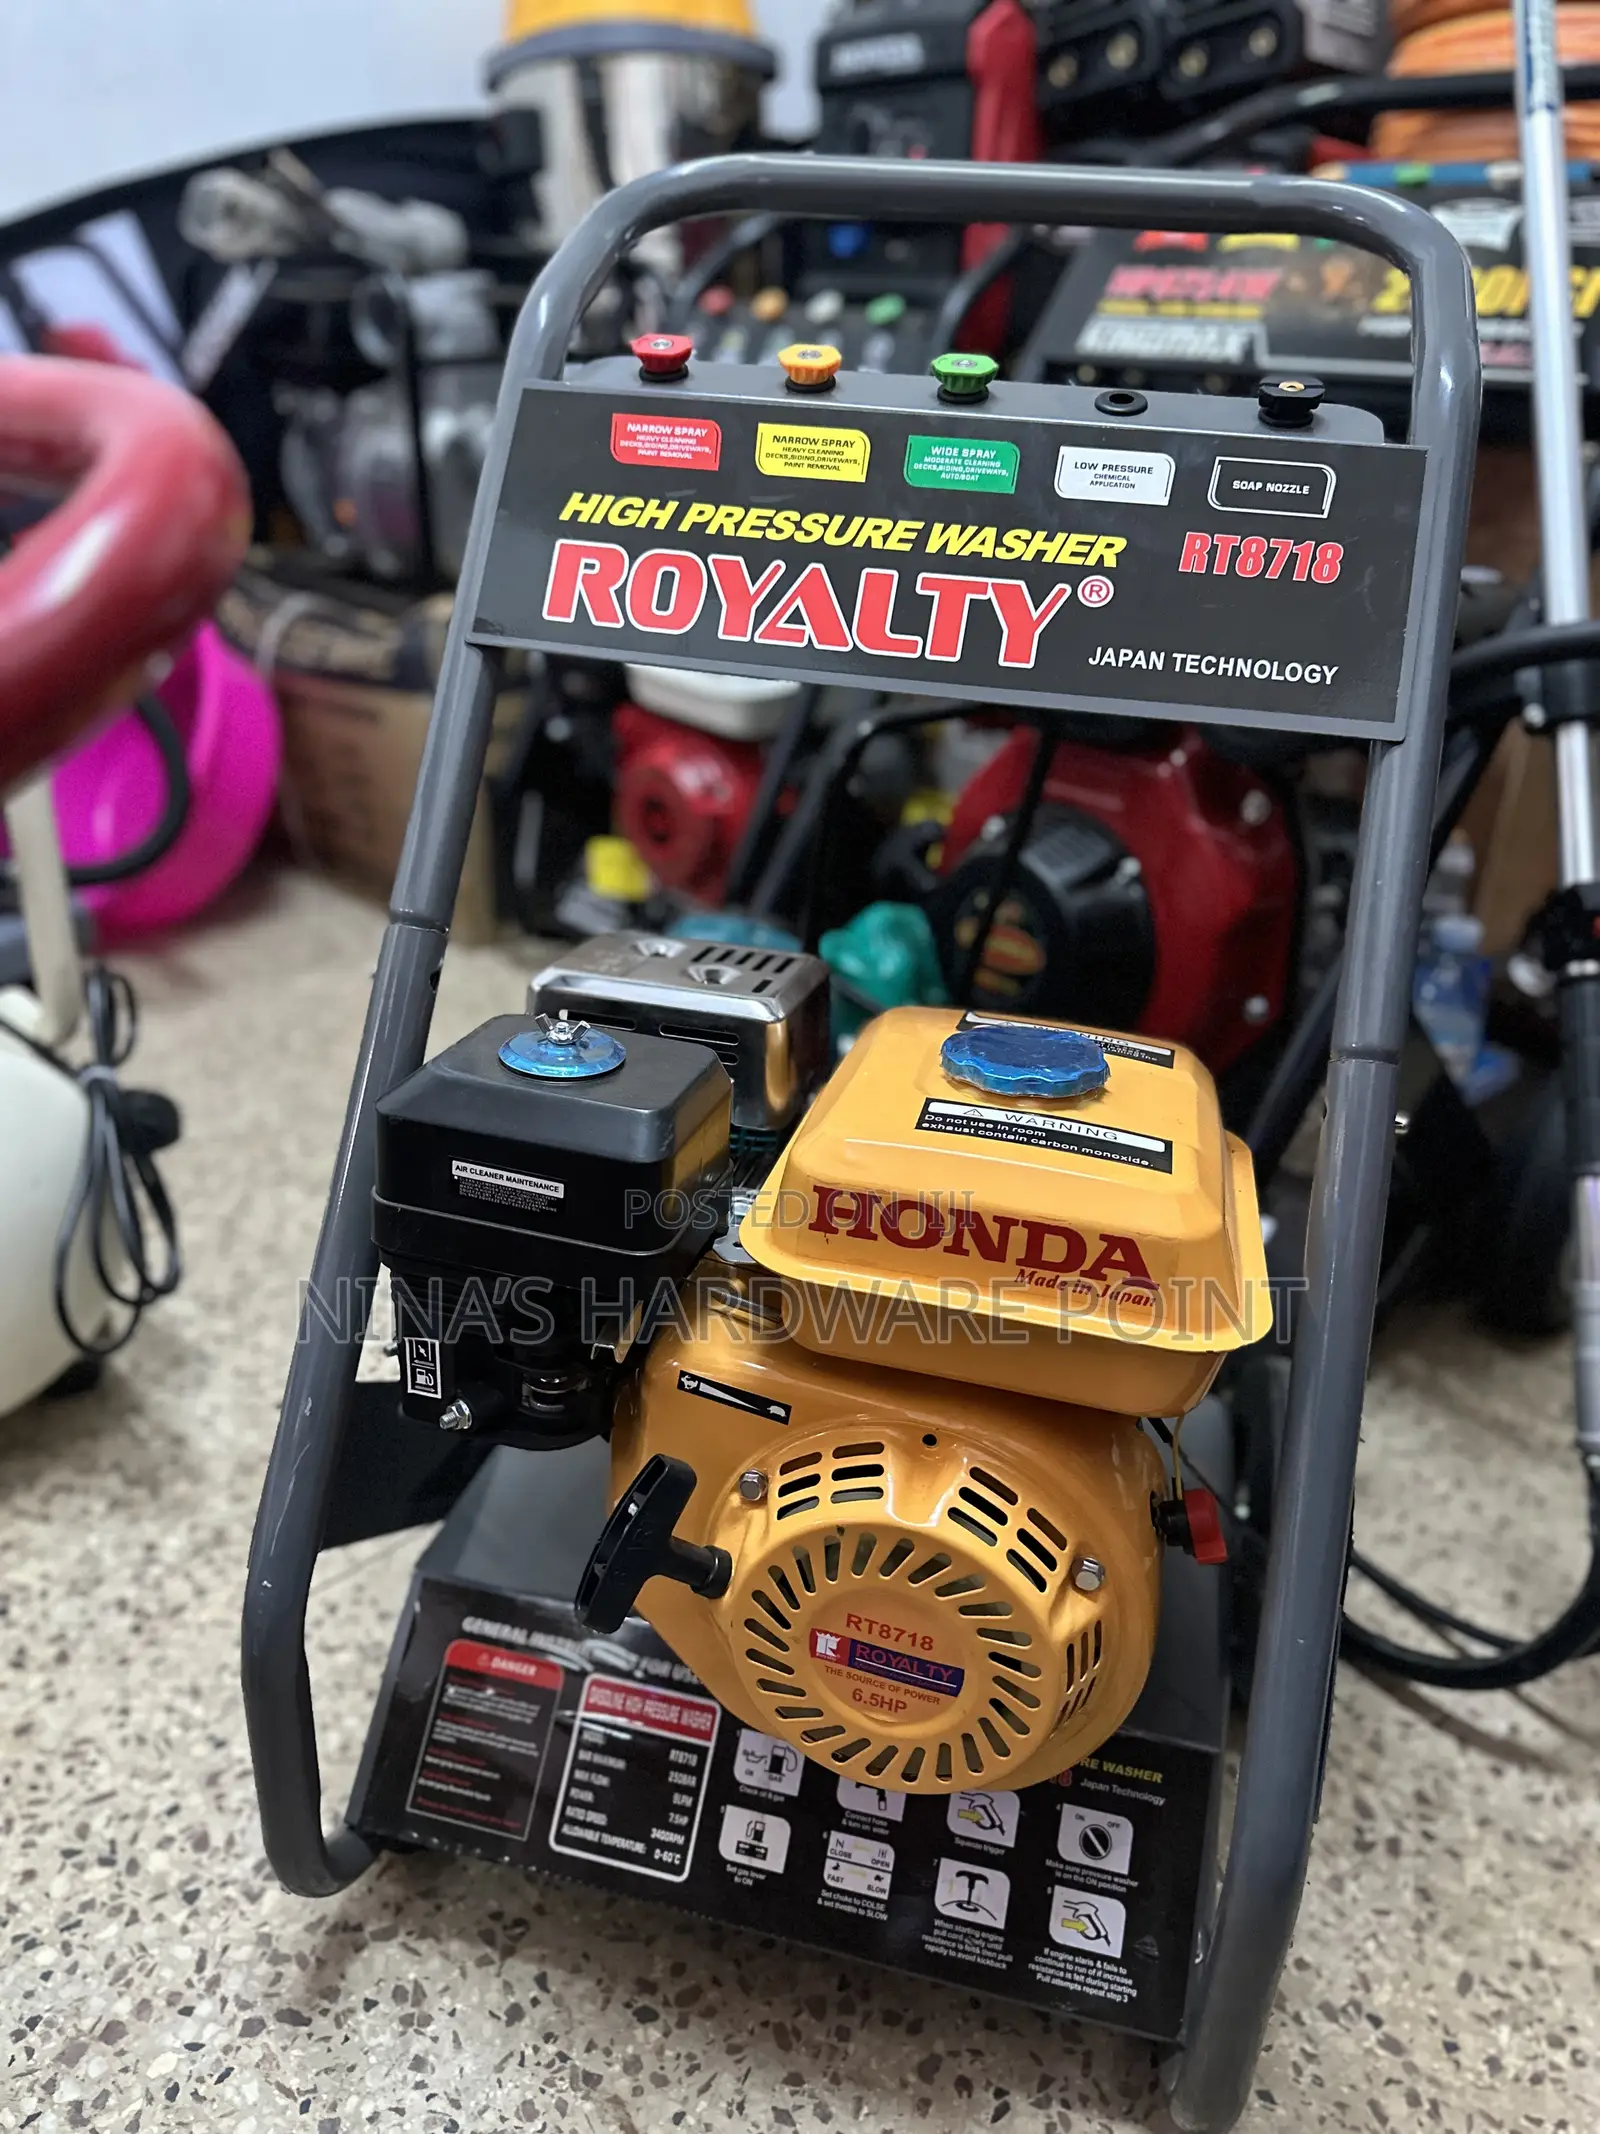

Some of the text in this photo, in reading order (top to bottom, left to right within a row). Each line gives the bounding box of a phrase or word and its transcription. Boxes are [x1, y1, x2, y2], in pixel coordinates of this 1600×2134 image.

[627, 422, 708, 437] NARROW SPRAY
[772, 435, 856, 449] NARROW SPRAY
[782, 446, 844, 457] HEAVY CLEANING
[659, 450, 693, 460] REMOVAL
[924, 456, 1001, 468] MODERATE CLEANING
[930, 446, 997, 460] WIDE SPRAY
[784, 461, 841, 472] PAINT REMOVAL
[1074, 461, 1154, 475] LOW PRESSURE
[1089, 480, 1135, 489] APPLICATION
[1093, 473, 1131, 482] CHEMICAL
[1232, 480, 1310, 495] SOAP NOZZLE
[558, 492, 1128, 568] HIGH PRESSURE WASHER
[1178, 531, 1344, 584] RT8718
[542, 538, 1072, 669] ROYALTY
[1088, 647, 1339, 685] JAPAN TECHNOLOGY
[925, 1114, 1046, 1137] Do not use in room
[1004, 1112, 1118, 1141] WARNING
[921, 1121, 1154, 1167] exhaust contain carbon monoxide.
[455, 1164, 560, 1193] AIR CLEANER MAINTENANCE
[807, 1184, 1161, 1291] HONDA
[1013, 1267, 1159, 1309] Made in Japan
[846, 1613, 934, 1651] RT8718
[855, 1643, 953, 1682] ROYALTY
[824, 1665, 844, 1677] THE
[846, 1671, 886, 1690] SOURCE
[888, 1684, 902, 1693] OF
[903, 1689, 941, 1705] POWER
[852, 1688, 908, 1714] 6.5HP
[1102, 1760, 1164, 1784] WASHER
[1080, 1777, 1109, 1792] Japan
[1111, 1784, 1166, 1807] Technology
[830, 1848, 852, 1859] CLOSE
[871, 1858, 890, 1868] OPEN
[827, 1873, 844, 1883] FAST
[1085, 1876, 1098, 1886] ON
[821, 1889, 832, 1898] Set
[866, 1884, 887, 1894] SLOW
[866, 1910, 888, 1920] SLOW
[1066, 1962, 1074, 1970] to
[1074, 1965, 1087, 1974] run
[1102, 1970, 1133, 1986] increase
[1095, 1960, 1102, 1969] &
[1119, 1967, 1127, 1975] to
[1036, 1972, 1051, 1983] Pull
[1051, 1977, 1082, 1992] attempts
[1082, 1984, 1106, 1997] repeat
[1085, 1974, 1109, 1990] during
[1109, 1981, 1138, 1997] starting
